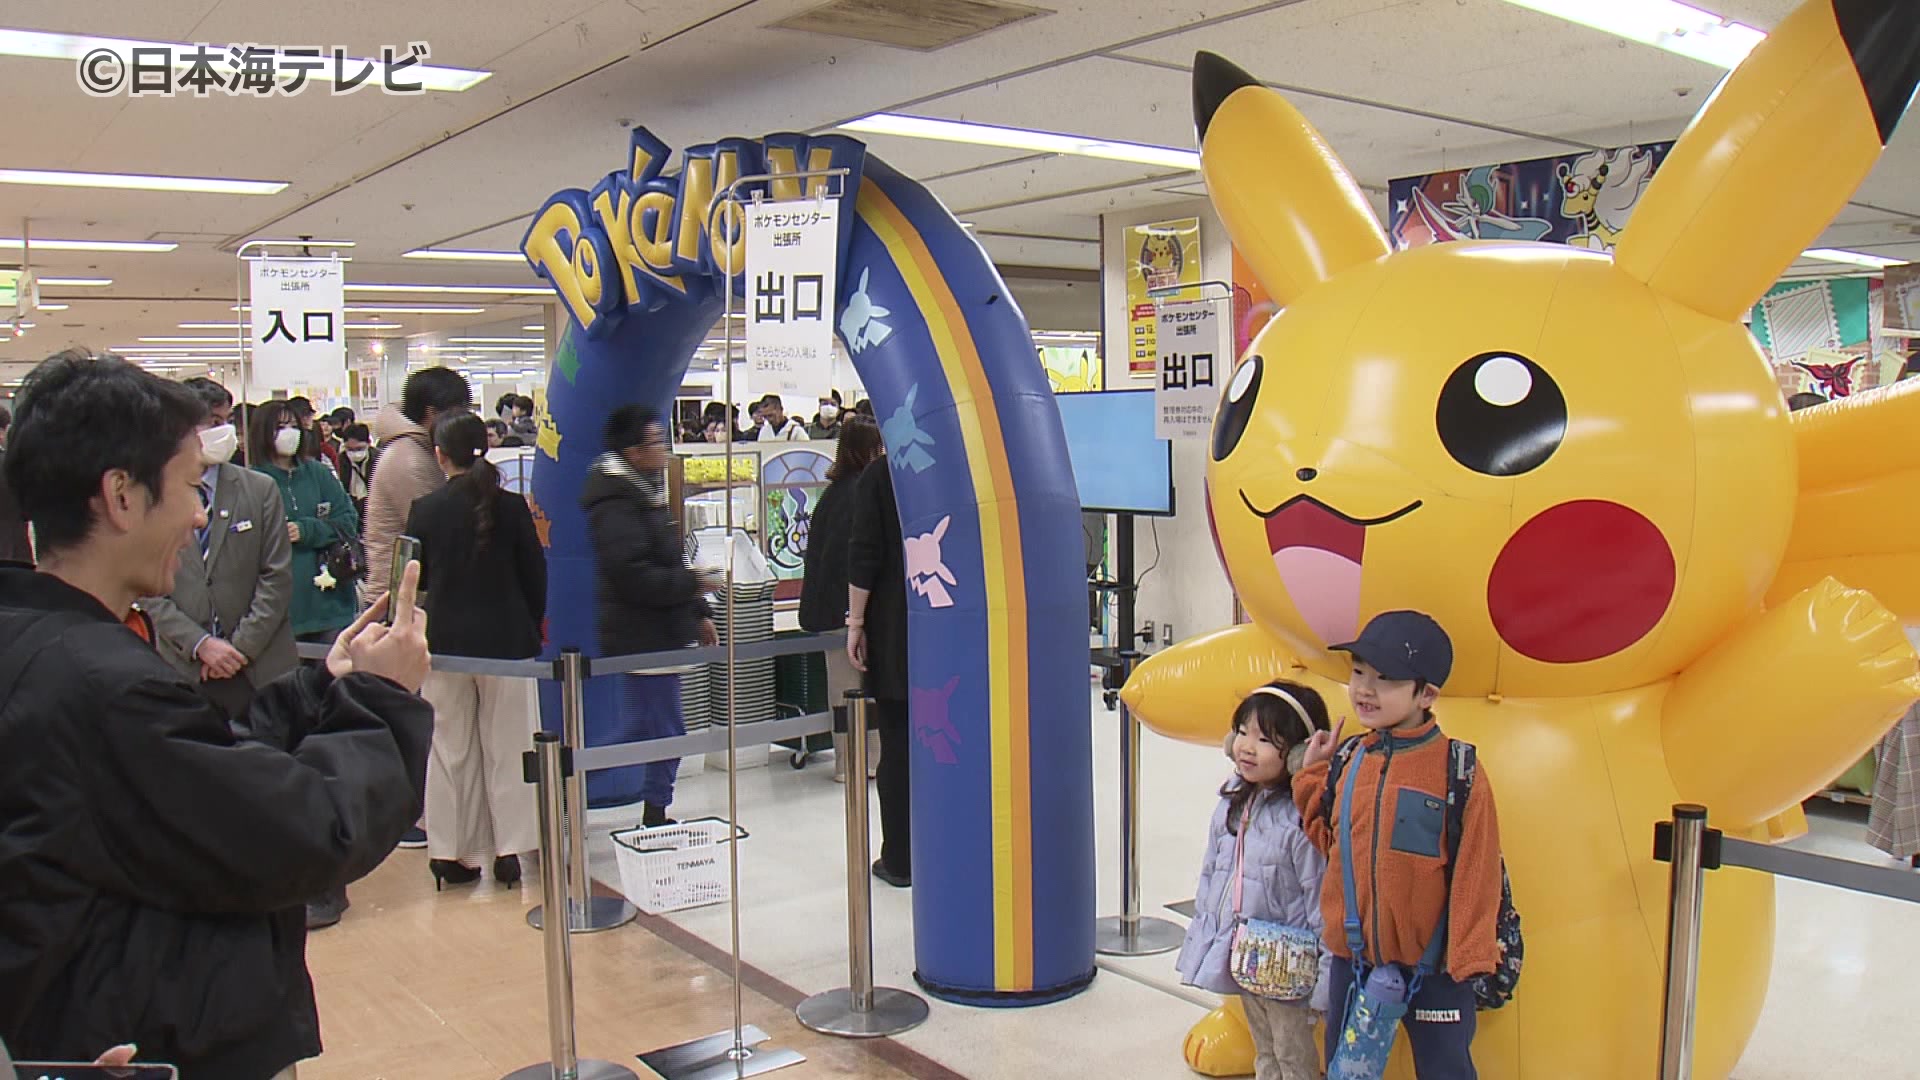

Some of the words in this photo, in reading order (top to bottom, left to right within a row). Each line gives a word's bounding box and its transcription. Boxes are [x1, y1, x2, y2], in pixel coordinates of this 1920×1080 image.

[755, 207, 832, 228] ポケモンセンター
[774, 231, 802, 247] 出張所
[259, 267, 339, 278] ポケモンセンター
[280, 281, 310, 292] 出張所
[755, 271, 824, 324] 出口
[1160, 309, 1216, 323] ポケモンセンター
[261, 310, 334, 344] 入口
[1175, 324, 1197, 336] 出張所
[1163, 352, 1213, 391] 出口
[676, 858, 716, 870] TENMAYA
[1415, 1009, 1461, 1023] BROOKLYN
